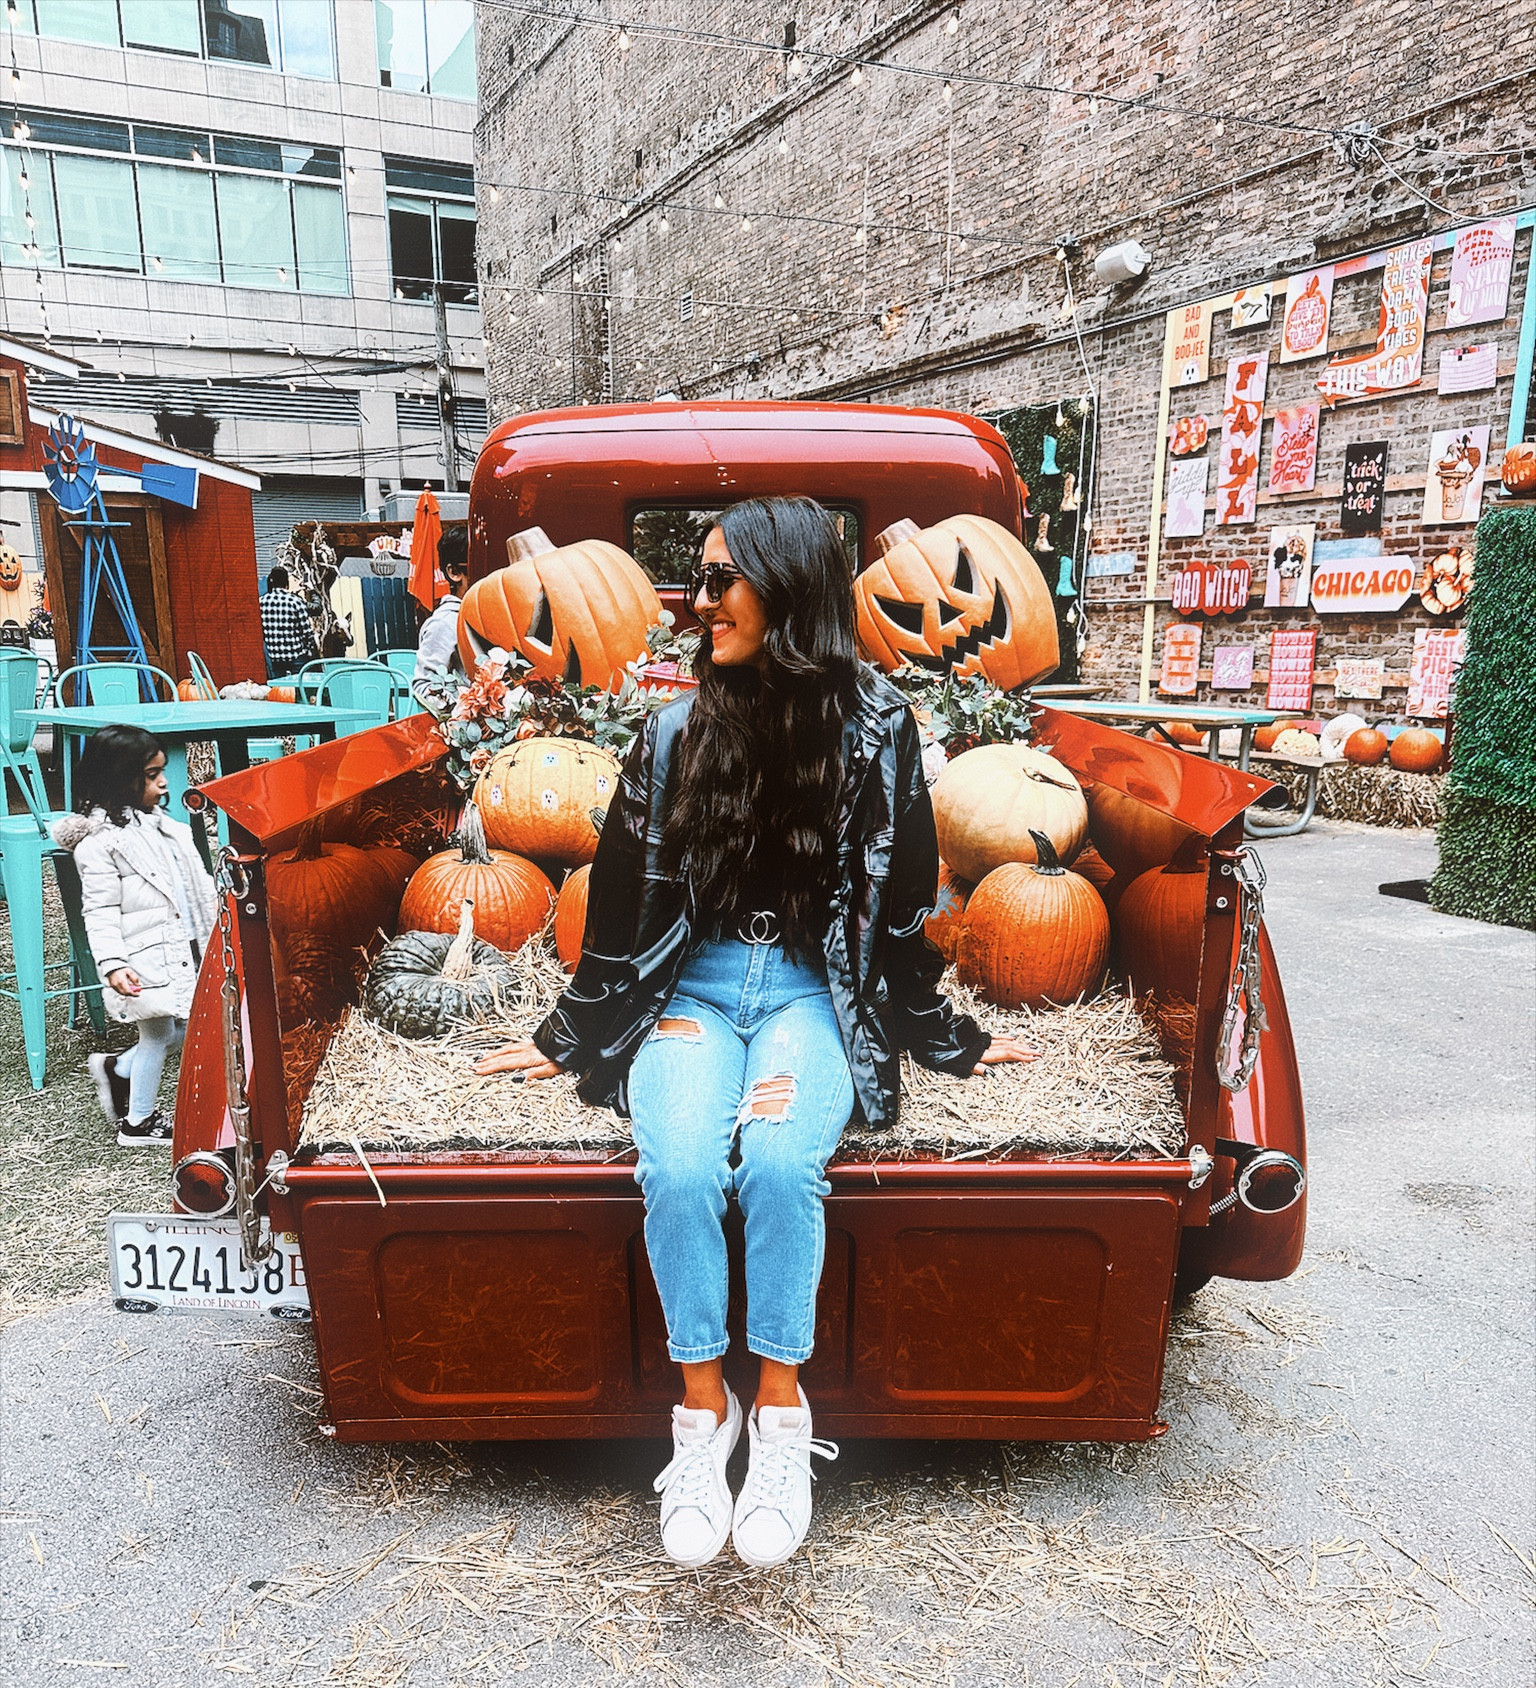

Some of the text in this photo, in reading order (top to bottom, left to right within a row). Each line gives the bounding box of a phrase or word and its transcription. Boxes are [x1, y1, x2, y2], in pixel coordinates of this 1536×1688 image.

[1387, 240, 1432, 267] SHAKES
[1386, 268, 1417, 288] FRIES
[1466, 260, 1509, 291] STATE
[1298, 299, 1319, 311] LET'S
[1388, 287, 1420, 308] DAMN
[1464, 283, 1507, 315] OF MIND
[1185, 305, 1201, 323] BAD
[1290, 309, 1308, 322] GIVE
[1387, 308, 1417, 328] GOOD
[1184, 324, 1200, 340] AND
[1384, 329, 1416, 350] VIBES
[1175, 340, 1205, 360] BOO-JEE
[1325, 353, 1419, 396] THIS WAY
[1225, 361, 1258, 516] FALL
[1277, 432, 1314, 457] Bless
[1272, 457, 1313, 485] Heart
[1351, 460, 1382, 481] trick
[1356, 481, 1371, 493] or
[1348, 494, 1376, 514] treat
[1173, 569, 1249, 609] BAD WITCH
[1313, 569, 1412, 598] CHICAGO
[1427, 641, 1455, 656] BEST
[1271, 658, 1312, 671] HOWDY
[1268, 696, 1310, 709] HOWDY
[120, 1243, 284, 1295] 3124158
[123, 1301, 149, 1311] Ford
[172, 1295, 261, 1309] LAND OF LINCOLN
[279, 1308, 304, 1318] Ford
